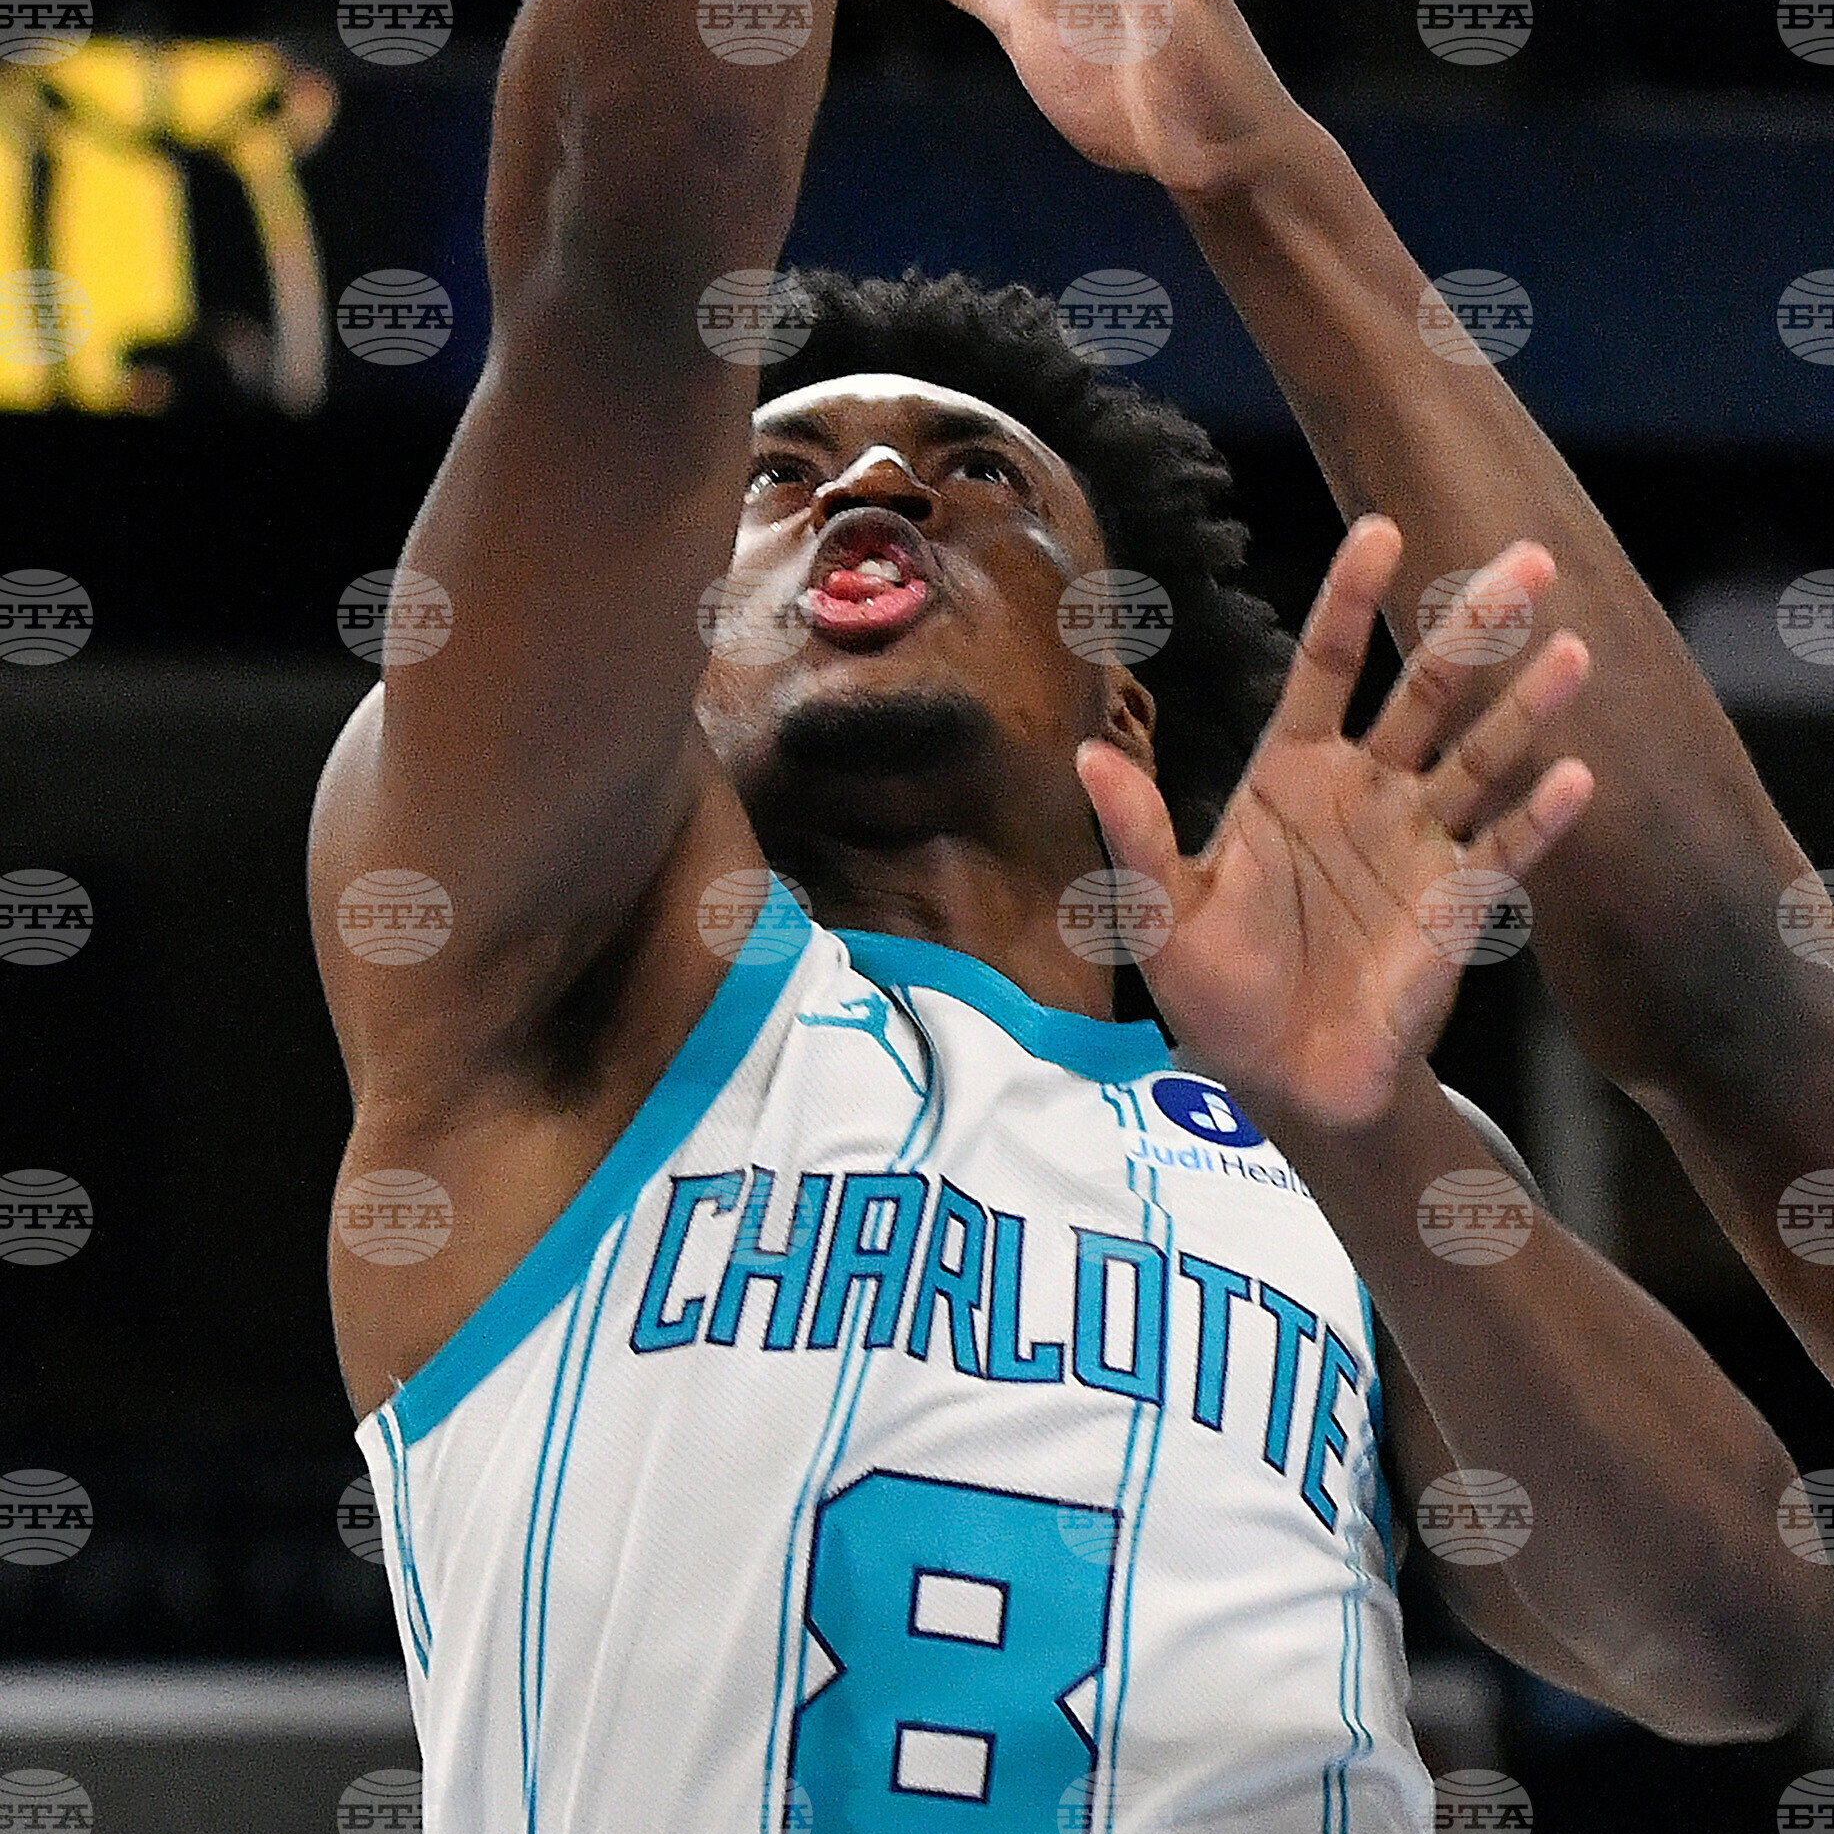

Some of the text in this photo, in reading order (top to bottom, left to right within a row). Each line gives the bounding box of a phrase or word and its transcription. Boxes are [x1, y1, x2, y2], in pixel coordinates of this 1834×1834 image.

[1132, 1136, 1313, 1200] Judi Healt
[630, 1166, 1359, 1533] CHARLOTTE
